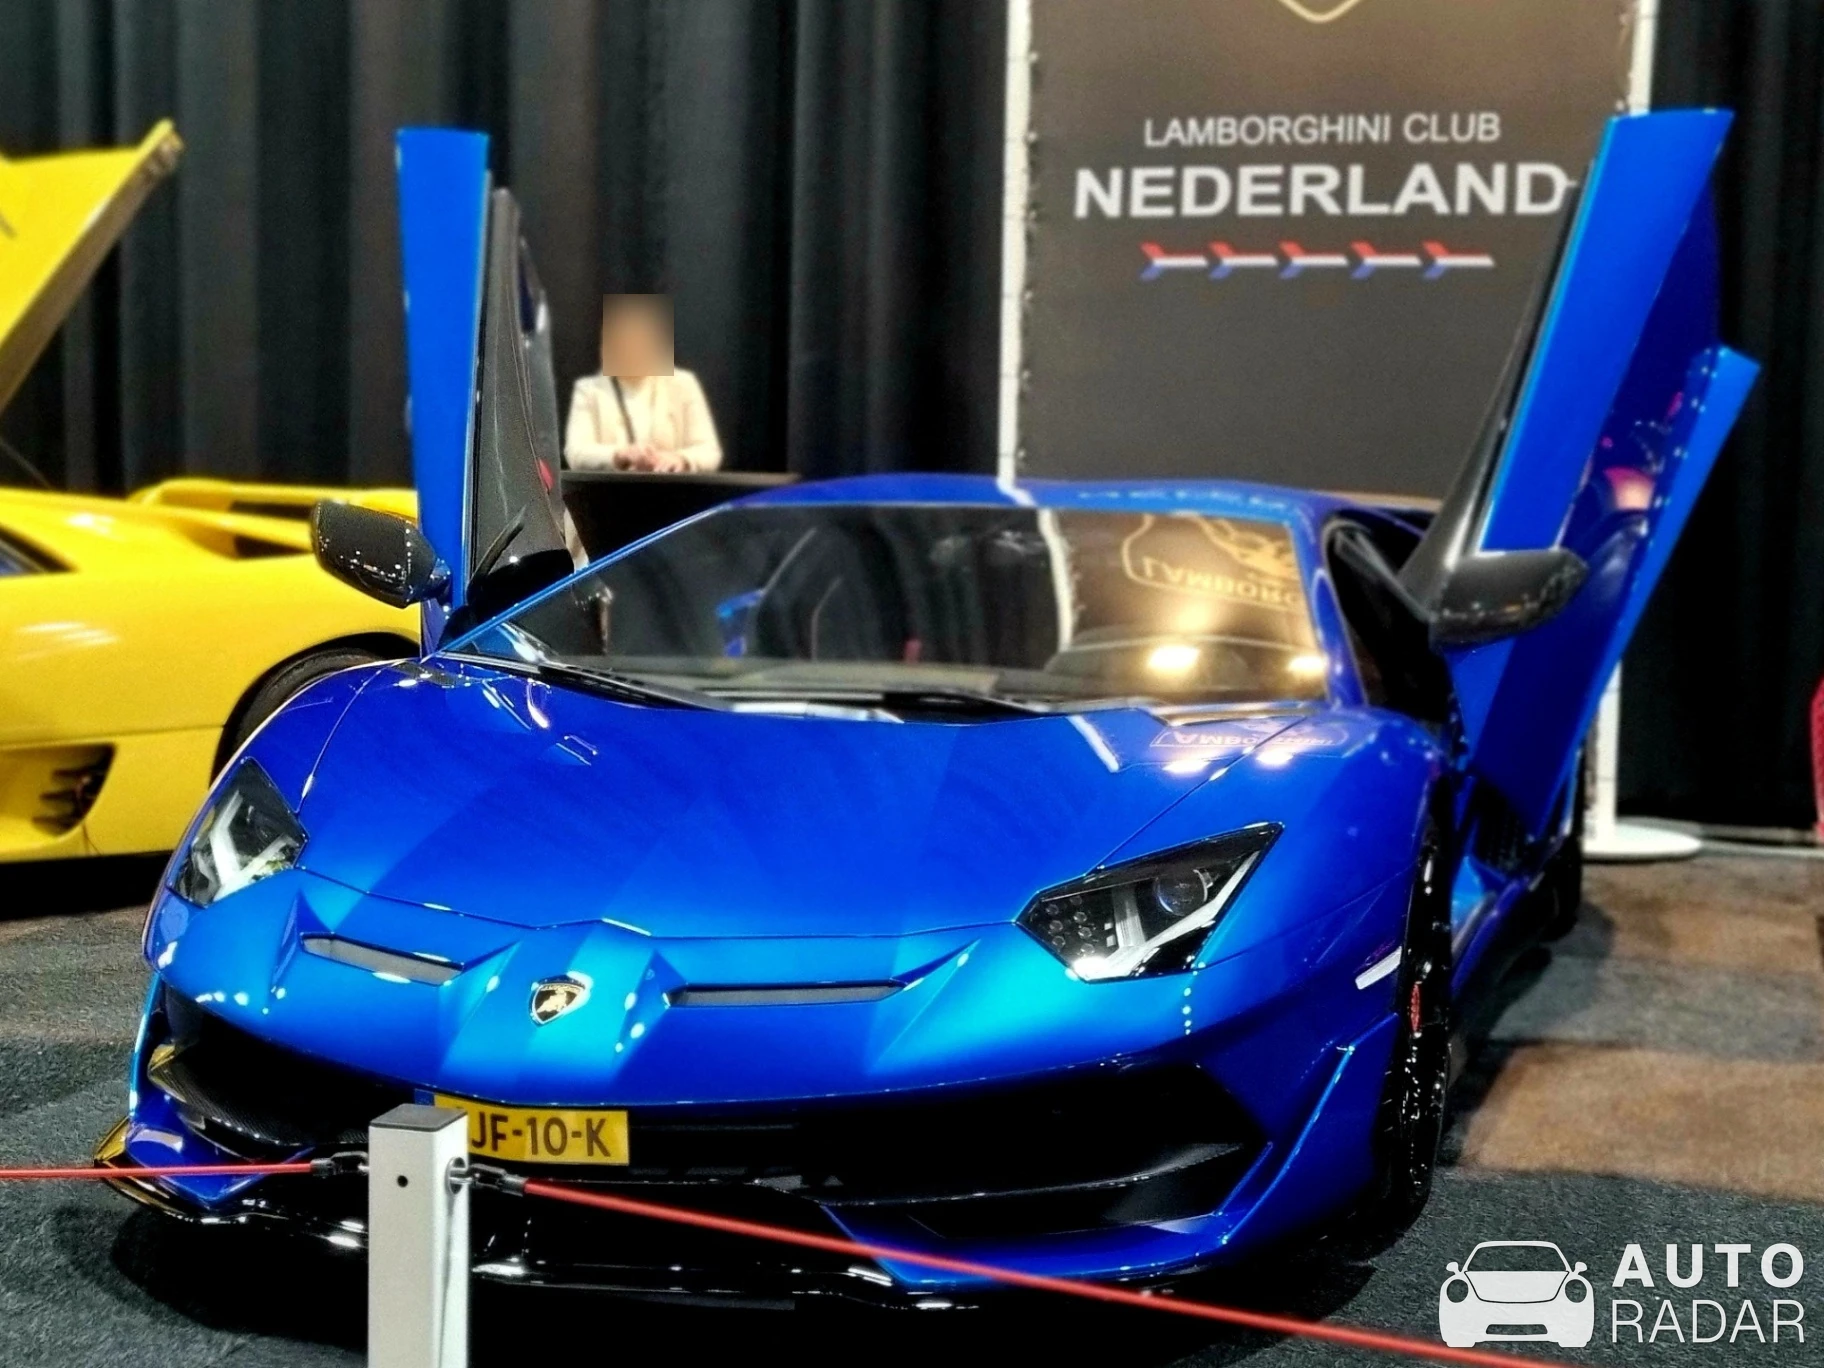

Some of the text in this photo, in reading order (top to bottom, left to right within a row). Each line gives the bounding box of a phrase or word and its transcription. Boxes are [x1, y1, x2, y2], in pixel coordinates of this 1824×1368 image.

[1143, 112, 1502, 148] LAMBORGHINI CLUB
[1073, 162, 1568, 218] NEDERLAND
[456, 1106, 611, 1157] JF-10-K
